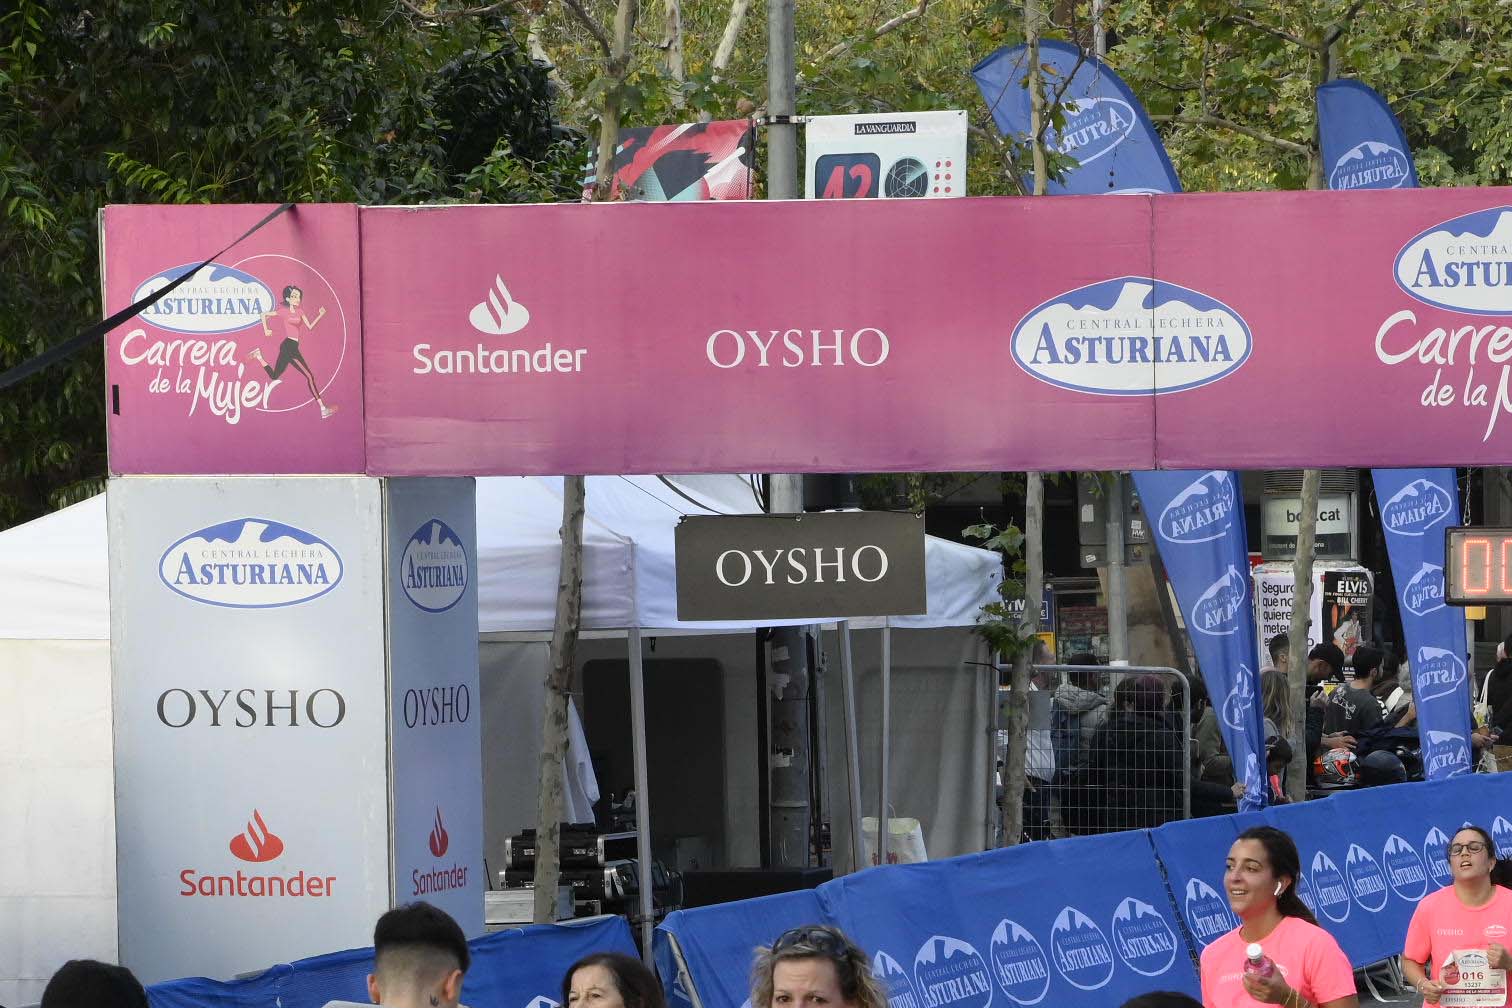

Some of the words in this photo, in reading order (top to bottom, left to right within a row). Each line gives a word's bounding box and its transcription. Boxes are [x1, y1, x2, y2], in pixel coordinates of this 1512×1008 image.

[867, 123, 915, 133] VANGUARDIA
[171, 287, 207, 295] ENTRAL
[1066, 318, 1142, 330] CENTRAL
[1149, 316, 1225, 328] LECHERA
[119, 328, 237, 367] Carrera
[412, 341, 588, 375] Santander
[706, 328, 890, 368] OYSHO
[1029, 321, 1234, 365] ASTURIANA
[149, 369, 171, 394] de
[175, 367, 192, 394] la
[189, 362, 283, 425] Mujer
[1420, 368, 1456, 408] de
[1462, 366, 1488, 408] la
[1286, 508, 1341, 523] bc.cat
[174, 551, 331, 586] ASTURIANA
[201, 550, 259, 559] CENTRAL
[265, 549, 324, 559] LECHERA
[406, 553, 465, 589] ASTURIANA
[715, 545, 889, 587] OYSHO
[1262, 597, 1279, 609] que
[1337, 580, 1368, 594] ELVIS
[1263, 609, 1295, 623] quiere
[156, 688, 346, 728] OYSHO
[403, 683, 470, 728] OYSHO
[179, 869, 337, 898] Santander
[412, 863, 468, 897] Santander
[995, 953, 1047, 987] ASTURIANA
[1056, 940, 1111, 973] ASTURIANA
[919, 969, 990, 1008] ASTURIANA
[1462, 971, 1484, 980] 016
